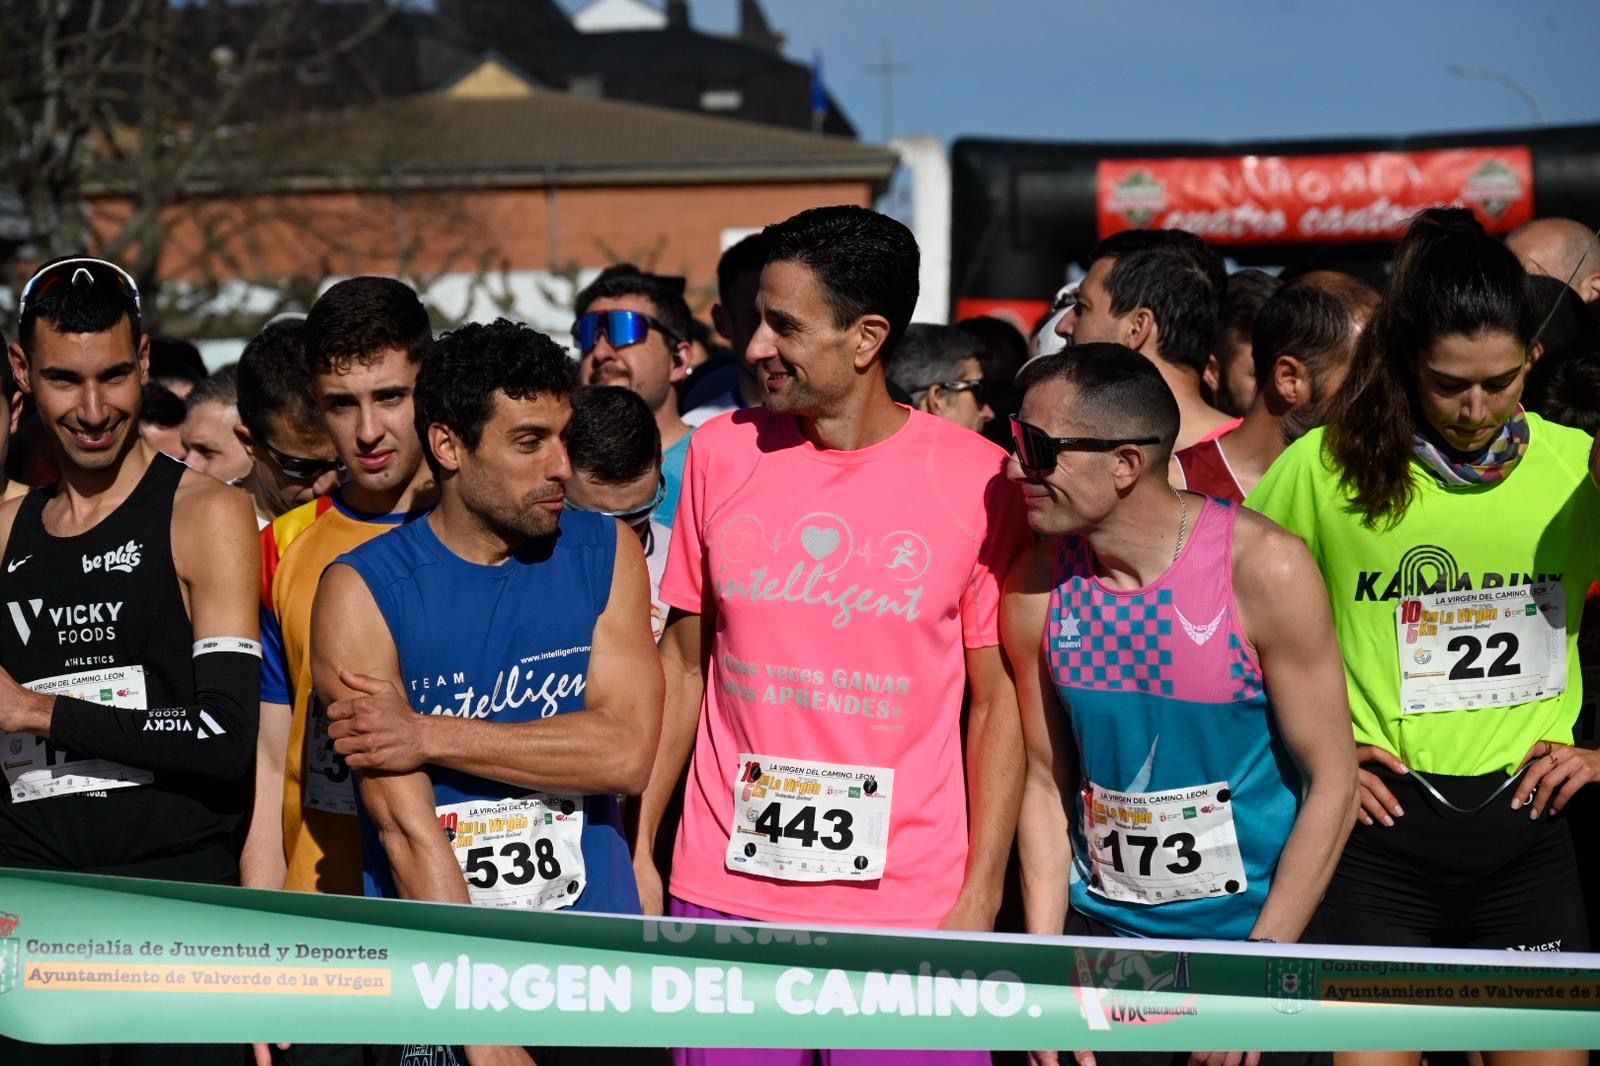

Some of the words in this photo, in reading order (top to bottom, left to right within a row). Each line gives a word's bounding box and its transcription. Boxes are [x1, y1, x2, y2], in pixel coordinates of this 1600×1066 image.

[715, 561, 924, 629] intelligent
[1435, 597, 1446, 605] LA
[1448, 594, 1477, 604] VIRGEN
[1479, 592, 1494, 600] DEL
[49, 601, 123, 627] VICKY
[1401, 600, 1422, 624] 10
[1457, 607, 1498, 624] Virgen
[58, 626, 116, 645] FOODS
[64, 655, 115, 668] ATHLETICS
[1447, 631, 1521, 681] 22
[34, 681, 57, 692] VIRGEN
[58, 679, 70, 688] DEL
[104, 672, 125, 681] LEON
[411, 672, 465, 690] TEAM
[832, 669, 910, 697] GANAS
[148, 709, 187, 717] FOODS
[143, 719, 193, 731] VICKY
[769, 763, 777, 771] LA
[779, 765, 805, 774] VIRGEN
[806, 768, 820, 776] DEL
[1109, 794, 1132, 803] VIRGEN
[1187, 789, 1208, 799] LEON
[469, 808, 480, 816] LA
[481, 805, 508, 815] VIRGEN
[489, 816, 529, 834] Virgen
[755, 801, 854, 851] 443
[1103, 829, 1203, 877] 173
[466, 838, 562, 889] 538
[26, 938, 134, 959] Concejalía
[139, 941, 164, 957] de
[169, 941, 271, 959] Juventud
[276, 946, 290, 961] y
[295, 943, 389, 962] Deportes
[1529, 939, 1562, 952] VICKY
[28, 968, 161, 987] Ayuntamiento
[164, 969, 187, 984] de
[191, 970, 272, 986] Valverde
[276, 972, 298, 987] de
[302, 972, 319, 987] la
[324, 973, 385, 991] Virgen
[650, 966, 755, 1014] DEL
[1324, 983, 1454, 1001] Ayuntamiento
[1459, 984, 1480, 999] de
[1484, 984, 1565, 1000] Valverde
[1569, 985, 1591, 1000] de
